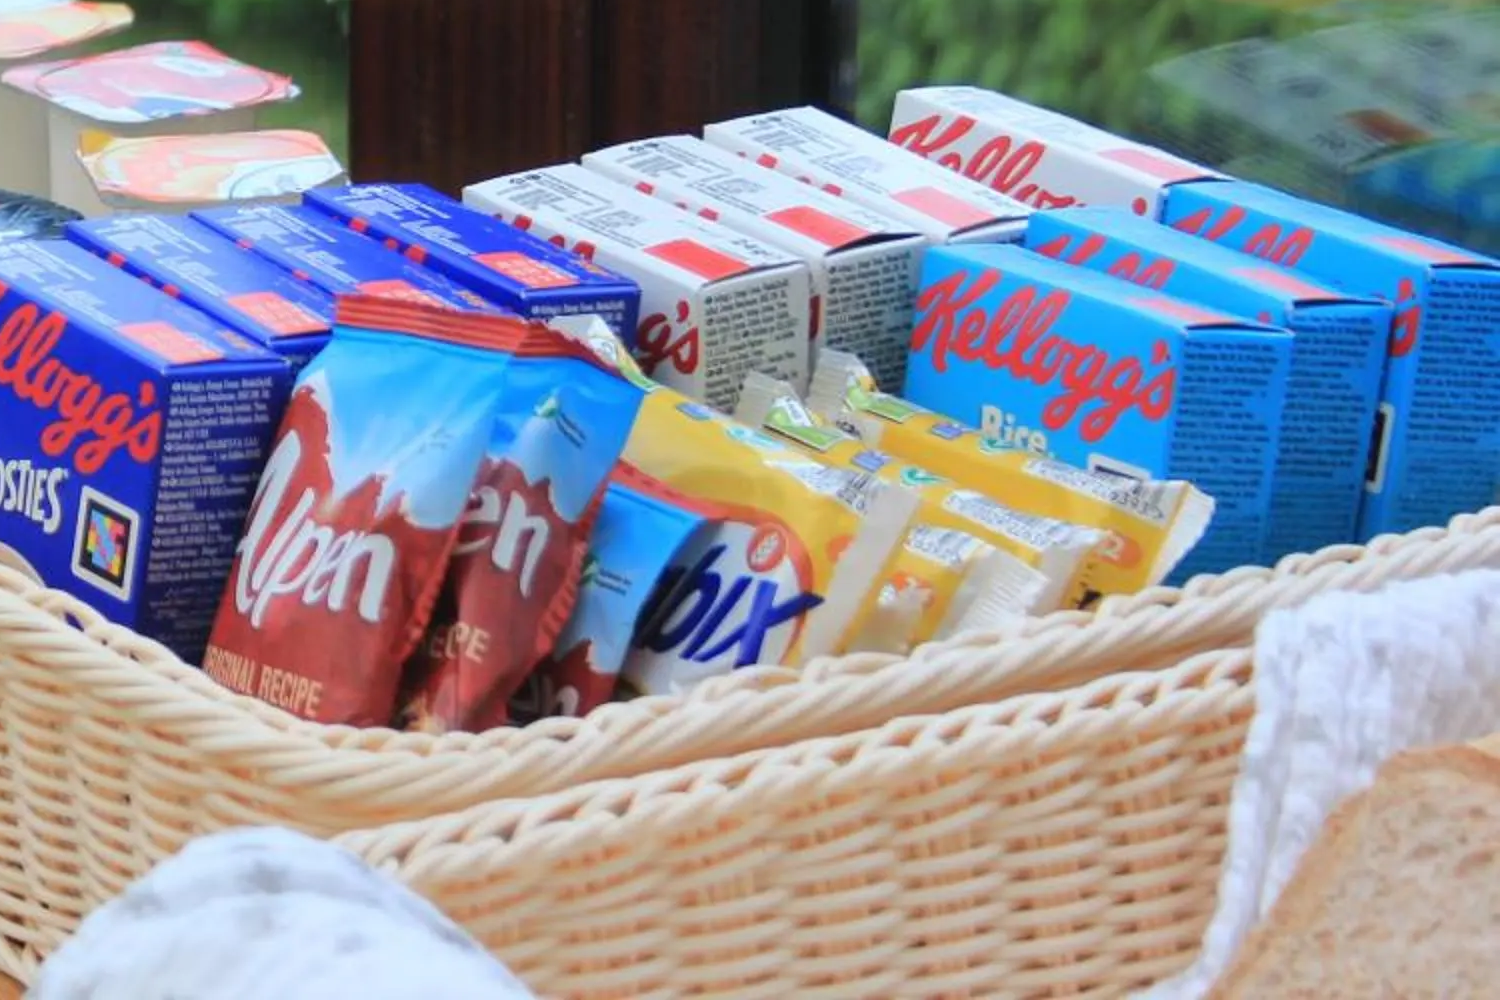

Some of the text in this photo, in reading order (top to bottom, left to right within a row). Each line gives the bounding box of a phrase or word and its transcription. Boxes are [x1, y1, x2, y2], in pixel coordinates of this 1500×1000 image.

[911, 268, 1178, 443] Kellogg's
[980, 404, 1048, 452] Rice
[235, 428, 397, 630] Alpen
[257, 664, 324, 719] RECIPE
